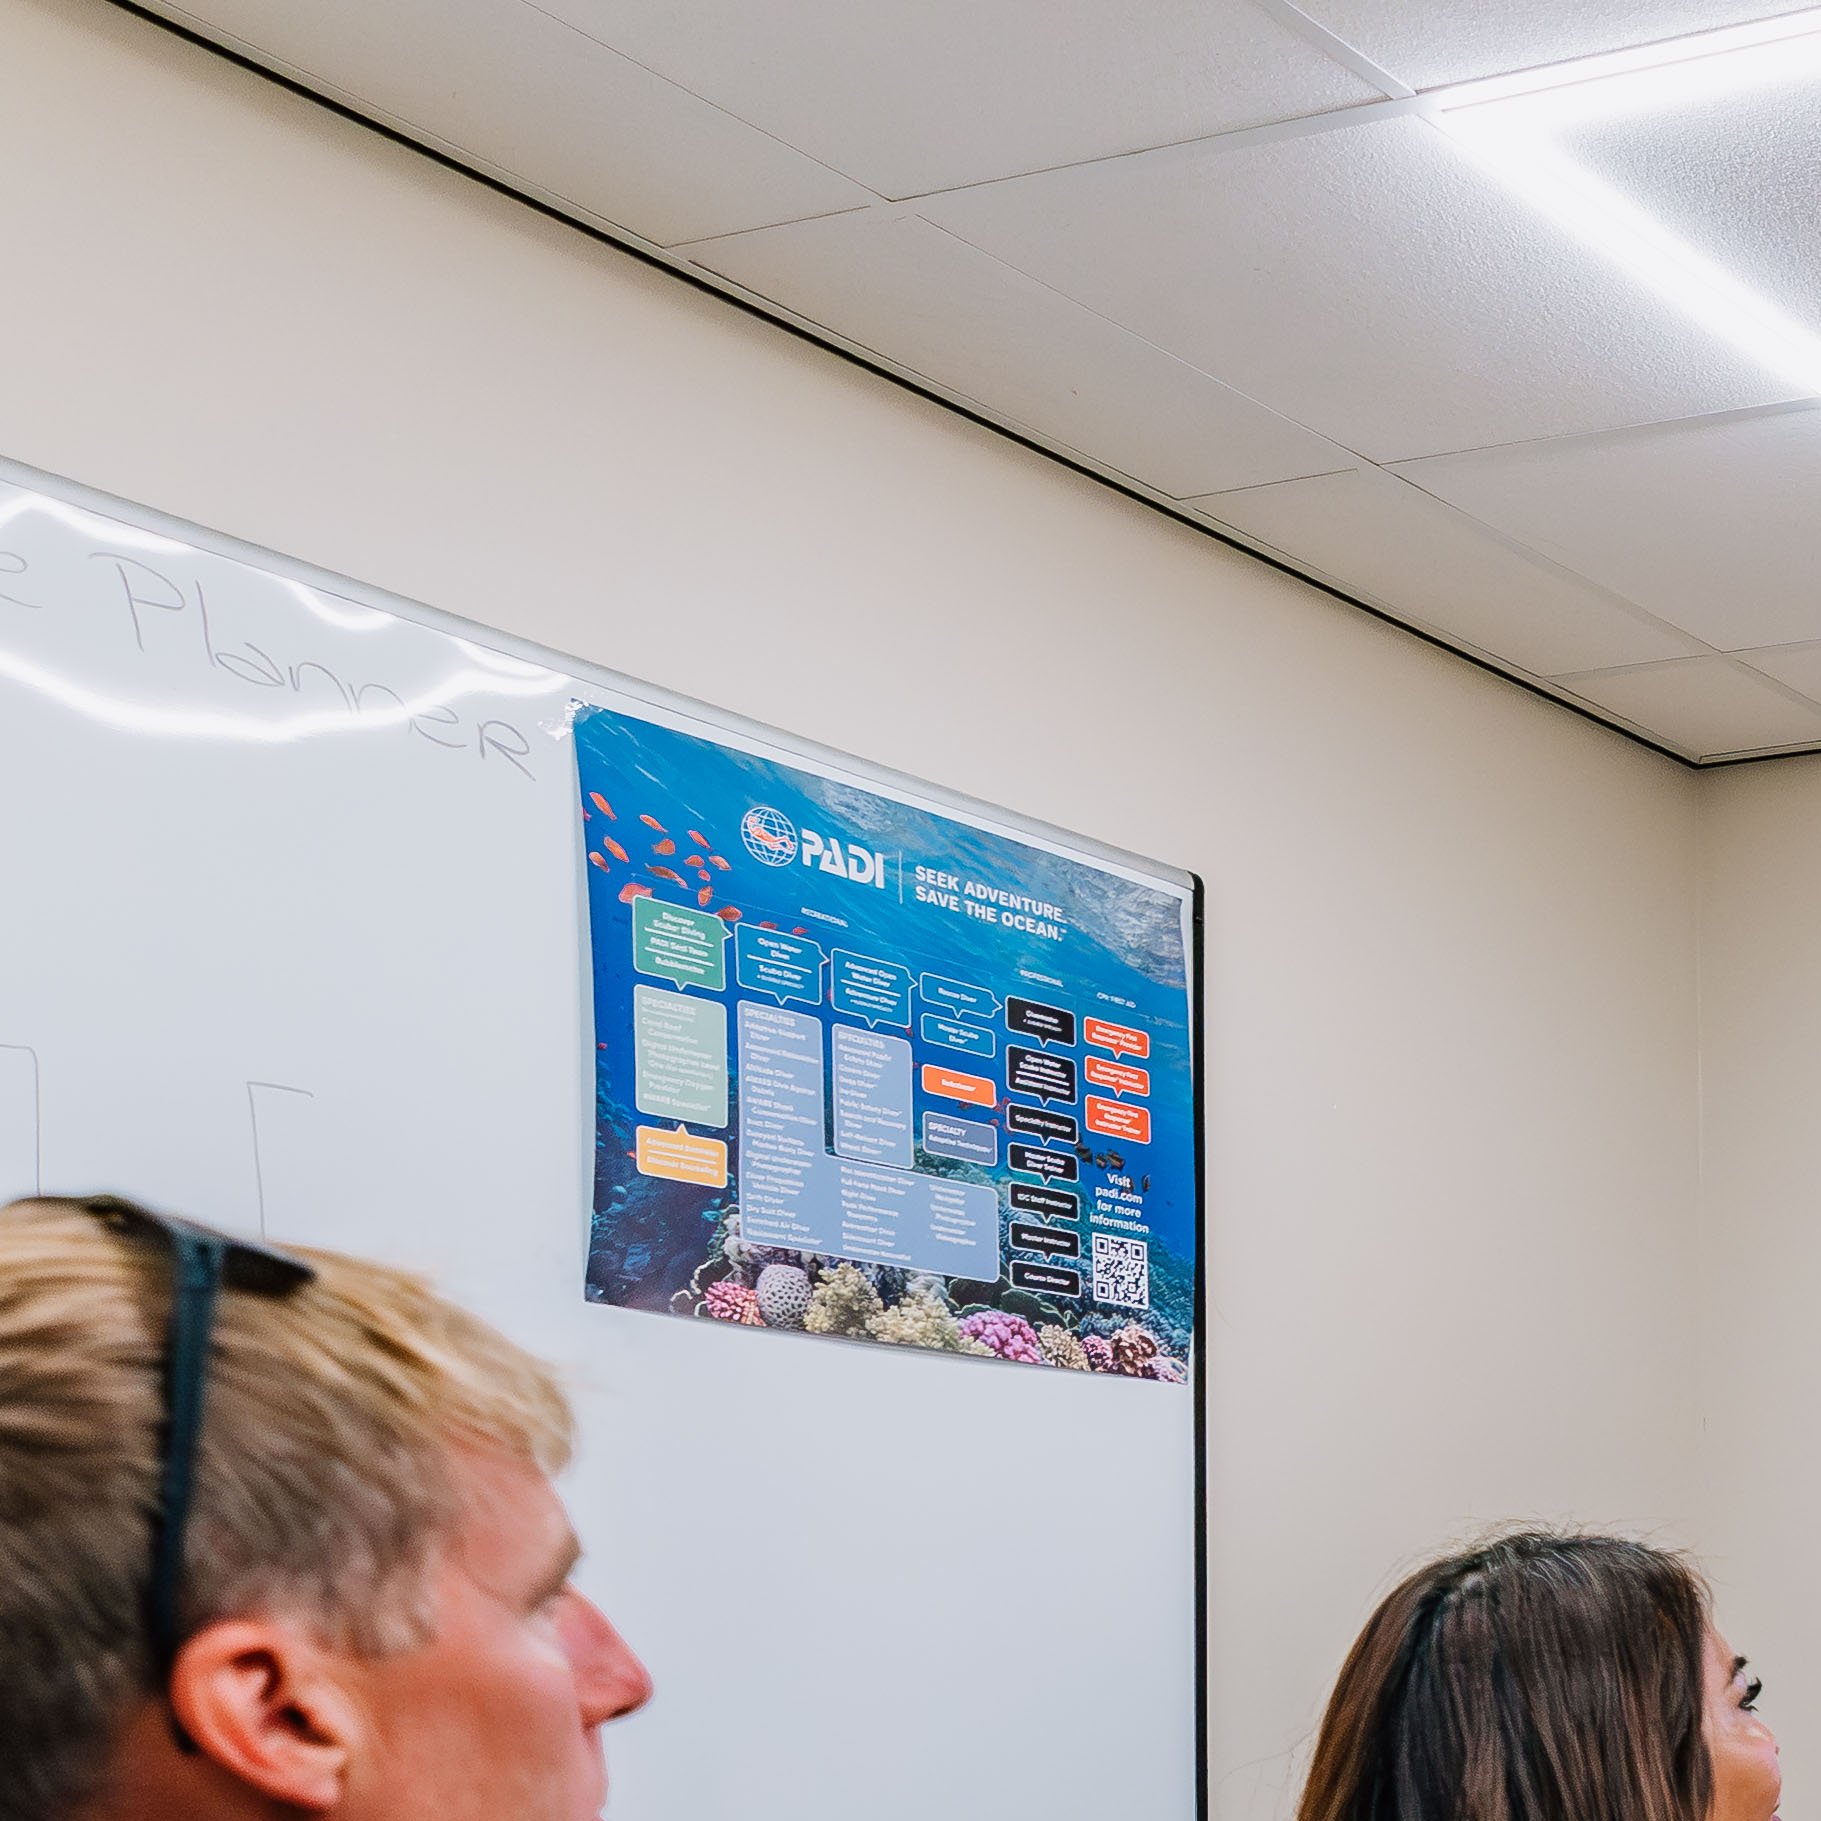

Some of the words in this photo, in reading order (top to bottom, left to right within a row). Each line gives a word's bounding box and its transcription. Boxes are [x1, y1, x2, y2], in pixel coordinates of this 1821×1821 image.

[801, 828, 885, 889] PADI
[915, 864, 959, 892] SEEK
[964, 880, 1068, 923] ADVENTURE.
[915, 885, 959, 912] SAVE
[964, 900, 997, 923] THE
[1107, 1173, 1131, 1188] Visit
[1095, 1186, 1143, 1205] padi.com
[1097, 1199, 1113, 1212] for
[1115, 1205, 1141, 1218] more
[1089, 1212, 1149, 1234] information
